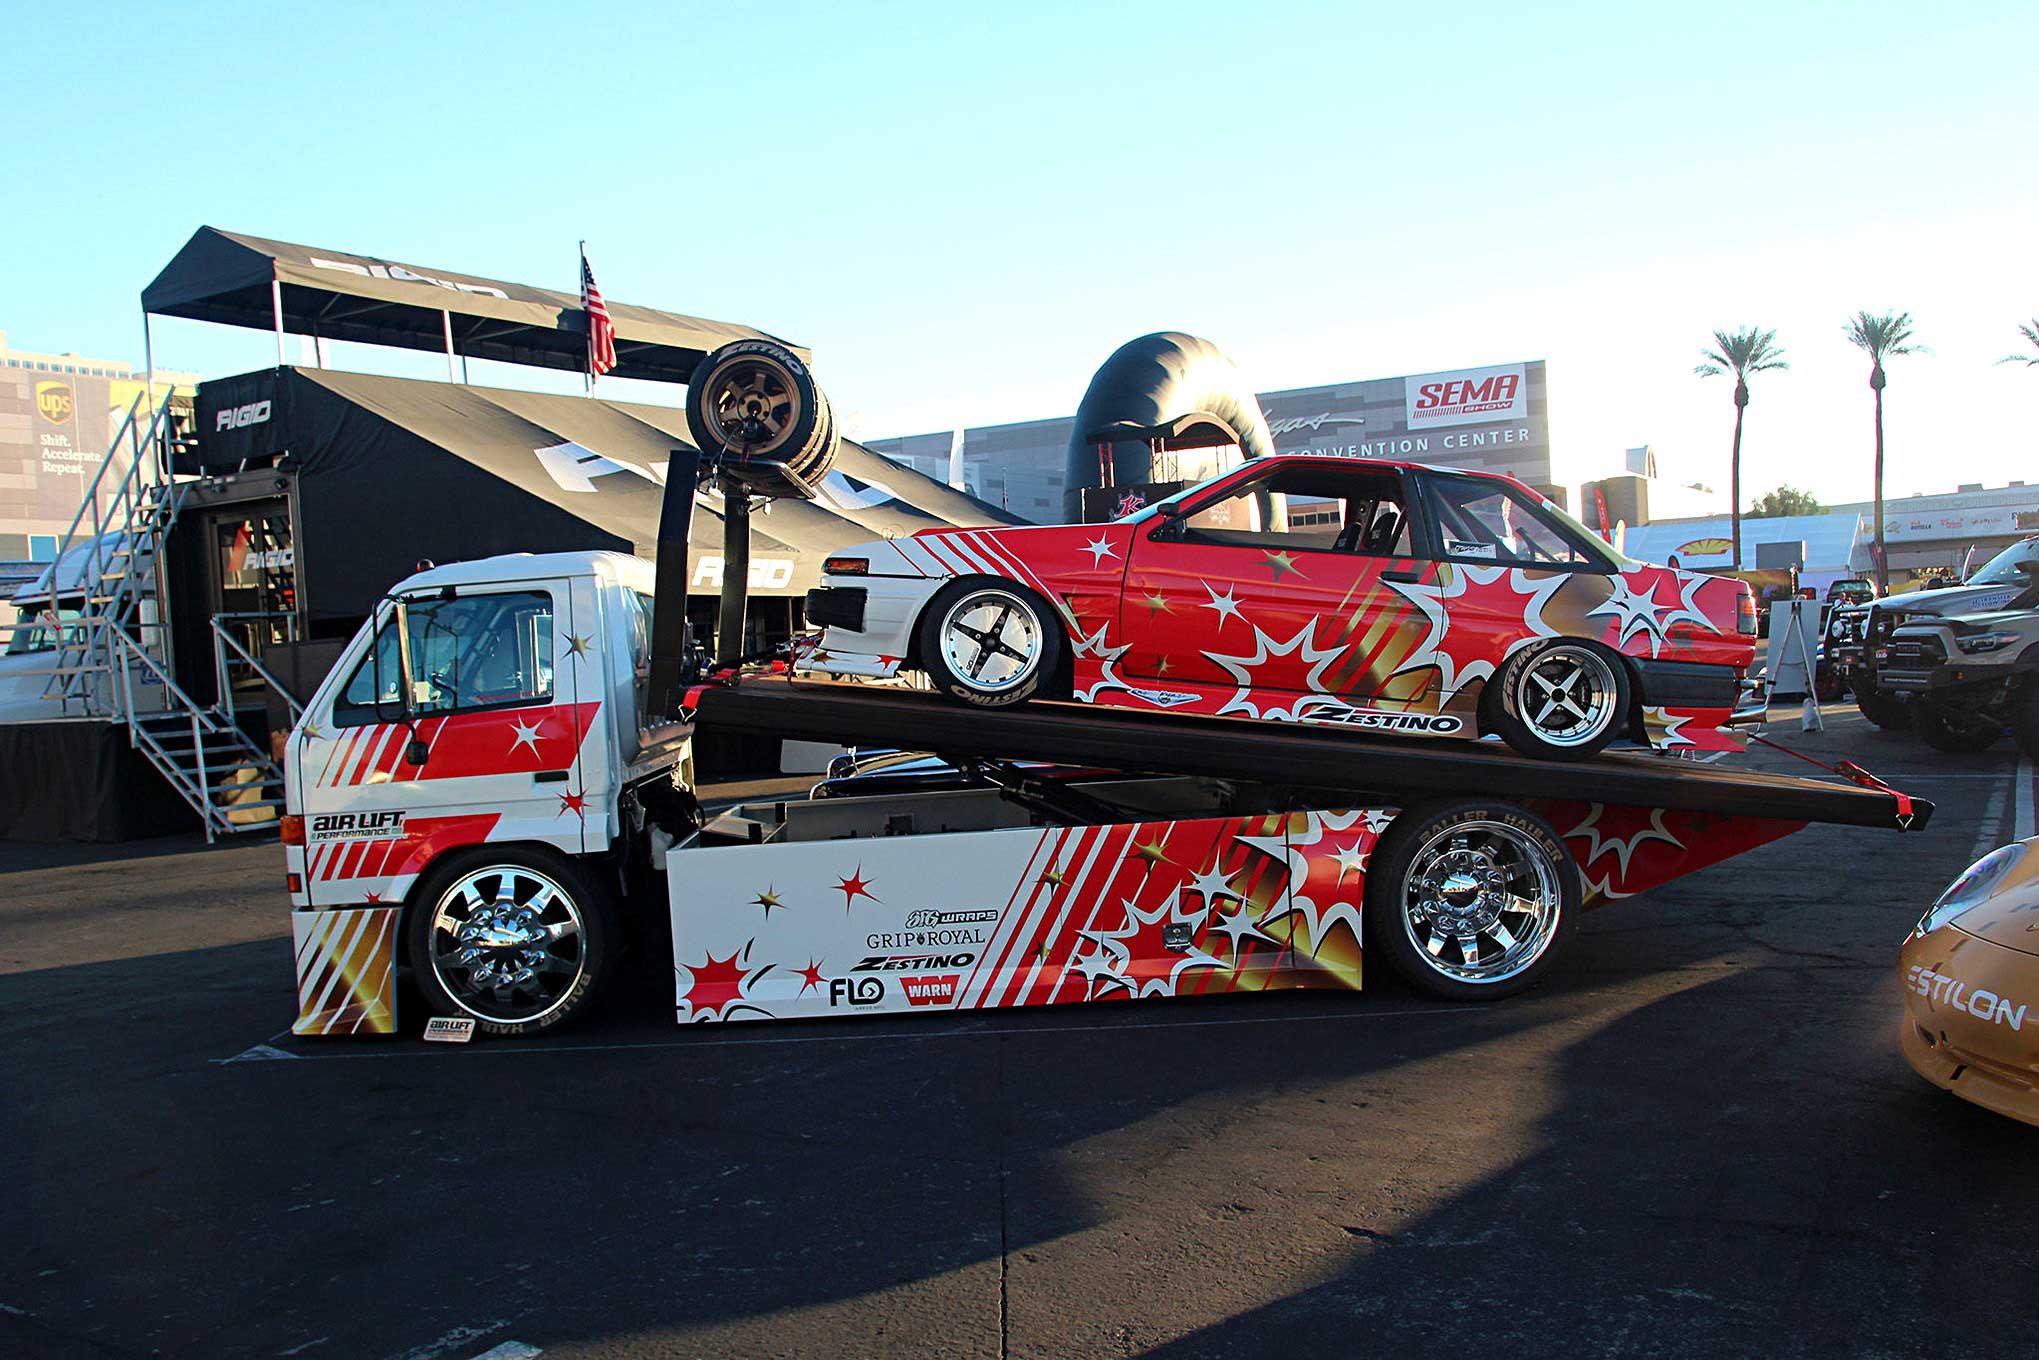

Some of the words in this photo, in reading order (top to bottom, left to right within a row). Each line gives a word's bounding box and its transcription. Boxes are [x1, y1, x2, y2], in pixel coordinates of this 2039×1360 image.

[1416, 374, 1519, 409] SEMA
[40, 393, 71, 418] ups
[1464, 401, 1511, 412] SHOW
[216, 400, 271, 432] RIGID
[40, 434, 71, 447] Shift.
[1444, 428, 1530, 449] CENTER
[42, 448, 104, 462] Accelerate.
[42, 461, 86, 476] Repeat.
[1306, 706, 1461, 732] ZESTINO
[358, 811, 406, 829] LIFT
[939, 910, 998, 924] WRAPS
[866, 931, 916, 948] GRIP
[928, 928, 986, 946] ROYAL
[850, 952, 976, 972] ZESTINO
[829, 977, 885, 1007] FLO
[908, 983, 952, 998] WARN
[450, 1021, 473, 1030] LIFT
